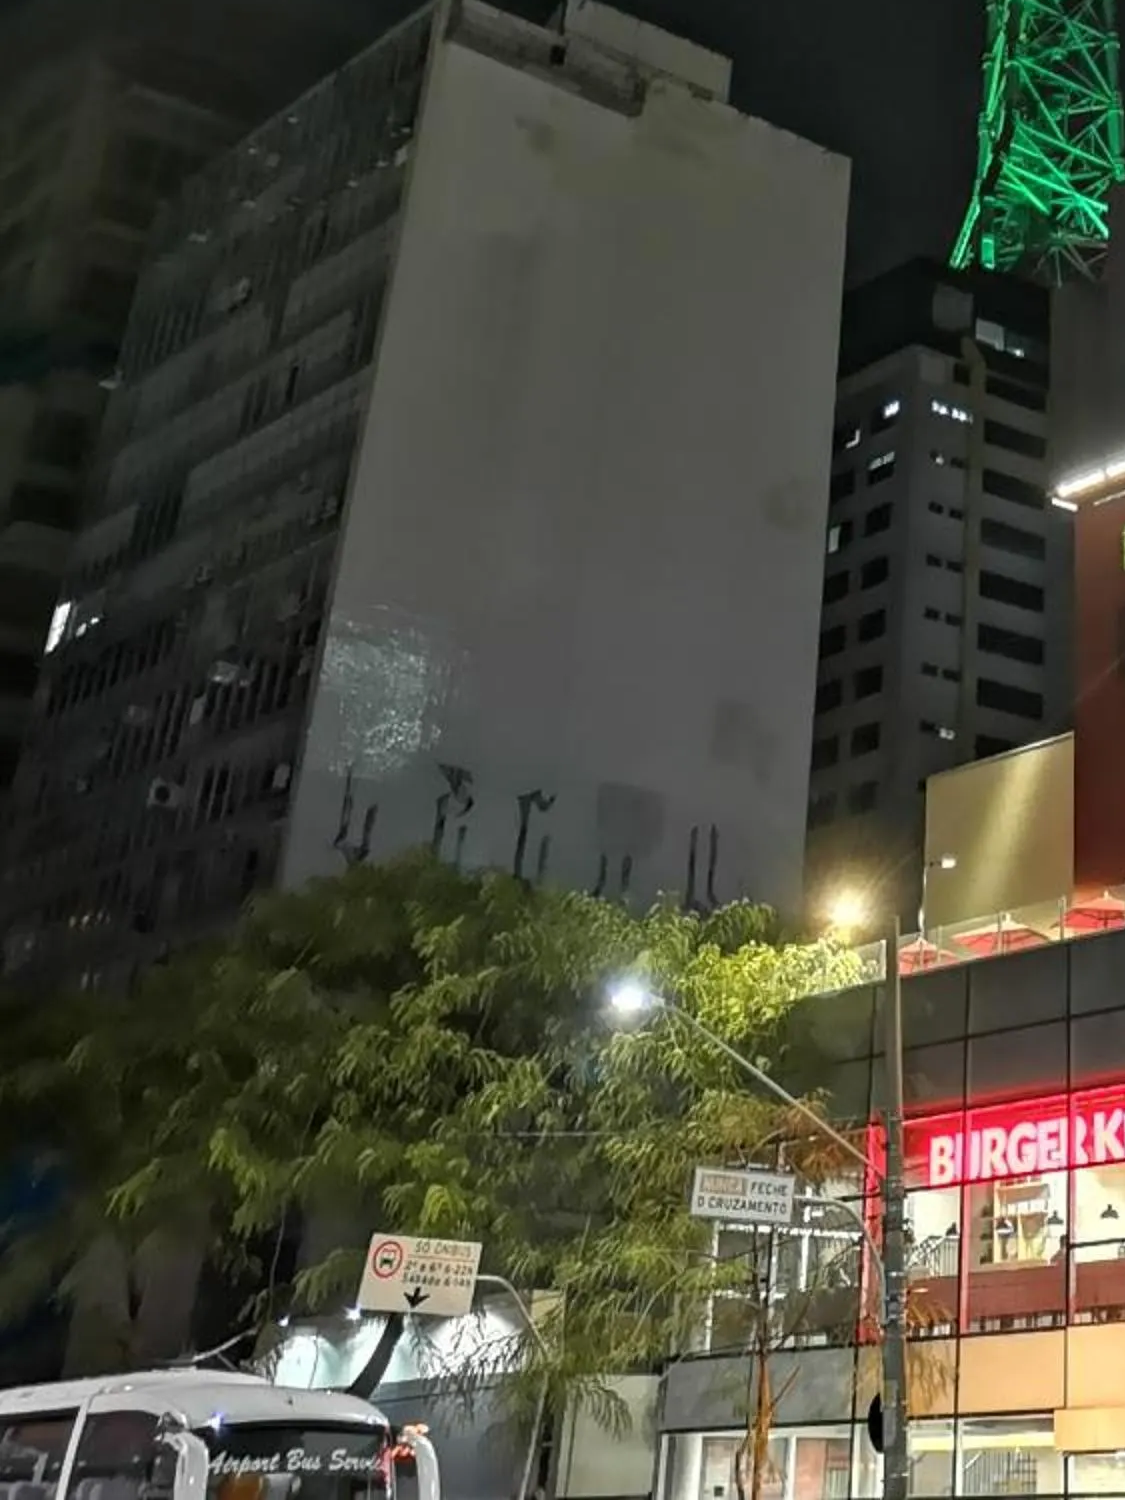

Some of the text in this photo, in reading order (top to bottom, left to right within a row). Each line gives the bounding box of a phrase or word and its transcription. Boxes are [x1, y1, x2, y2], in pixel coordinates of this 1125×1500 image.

[930, 1115, 1089, 1186] BURGER
[751, 1181, 788, 1197] FECHE
[707, 1195, 787, 1214] CRUZAMENTO
[208, 1450, 281, 1477] Airport
[287, 1448, 321, 1471] Bus
